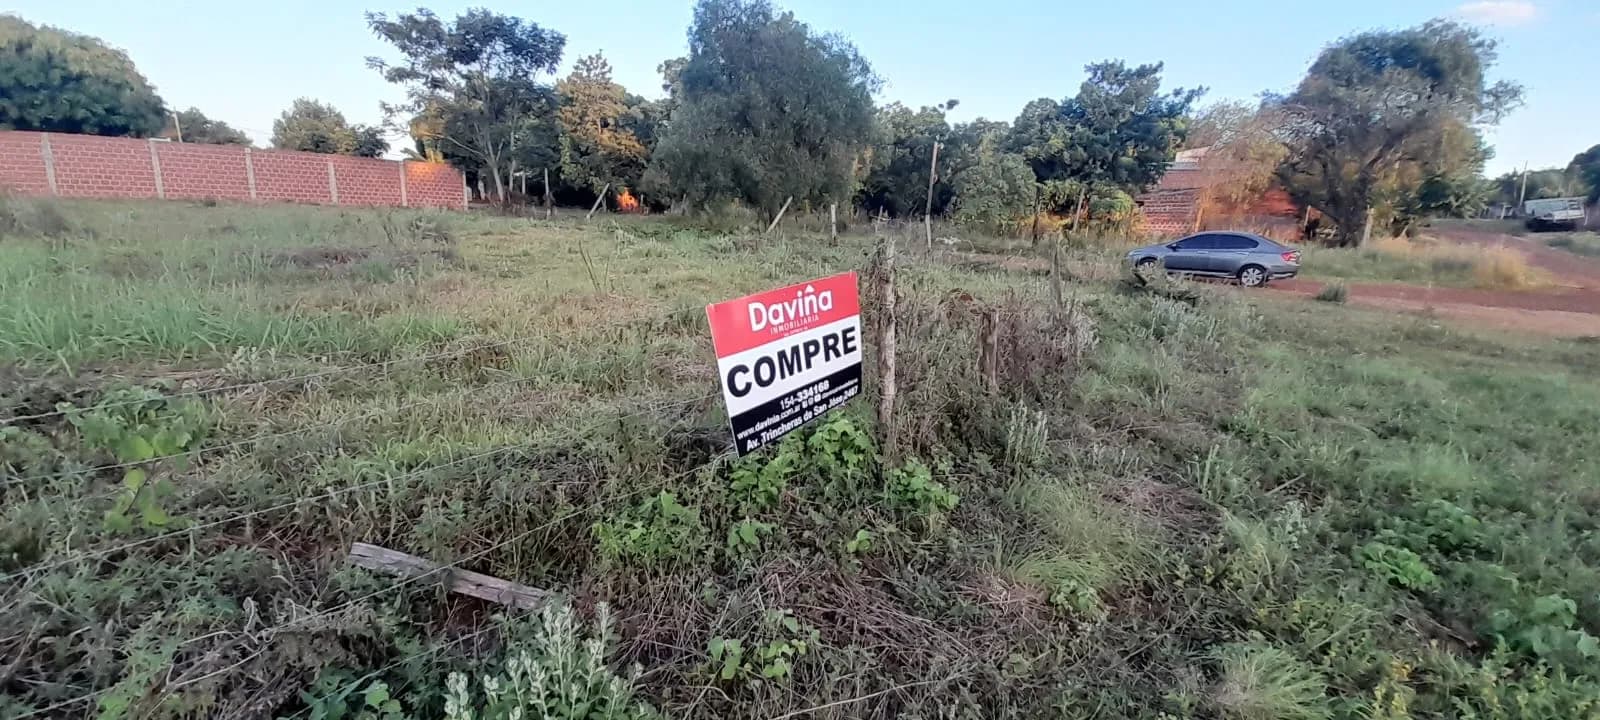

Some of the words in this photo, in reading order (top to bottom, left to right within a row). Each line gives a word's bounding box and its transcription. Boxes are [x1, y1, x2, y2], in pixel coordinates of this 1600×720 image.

[770, 314, 819, 335] INMOBILIARIA
[727, 326, 857, 398] COMPRE
[746, 439, 760, 452] Av.
[761, 416, 802, 442] Trincheras
[803, 409, 813, 421] de
[813, 403, 827, 416] San
